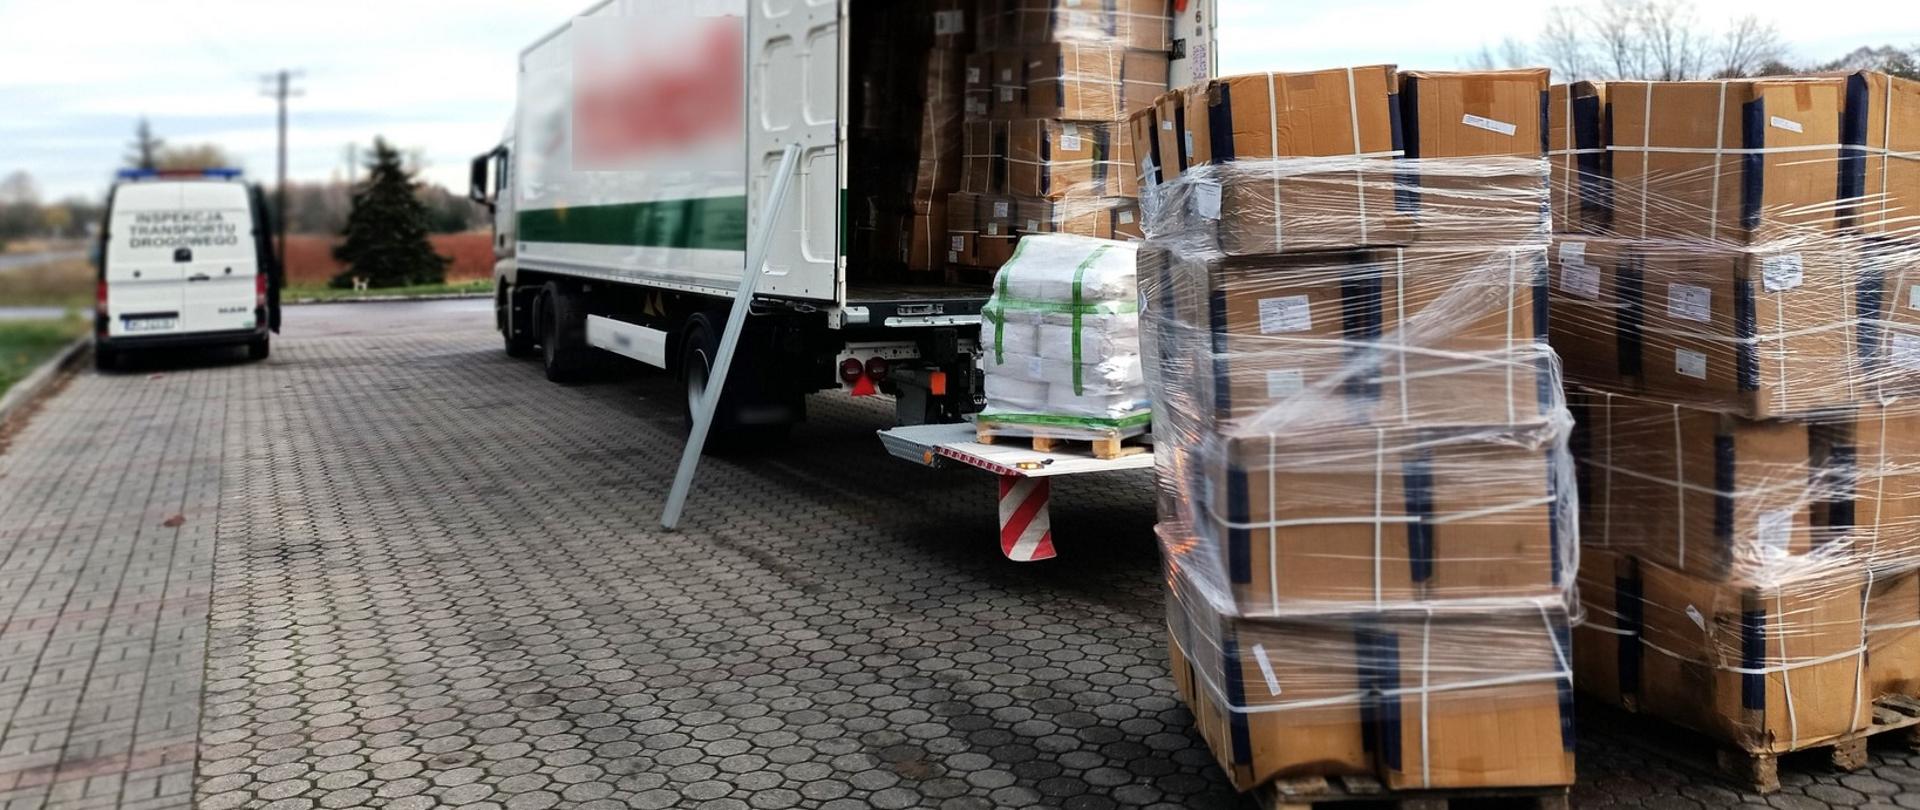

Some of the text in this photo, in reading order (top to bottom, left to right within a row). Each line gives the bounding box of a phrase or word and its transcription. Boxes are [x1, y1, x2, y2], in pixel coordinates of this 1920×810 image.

[136, 212, 223, 223] INSPEKCJA
[130, 224, 236, 235] TRANSPORTU
[129, 235, 238, 248] DROGOWEGO
[218, 306, 248, 314] MAN
